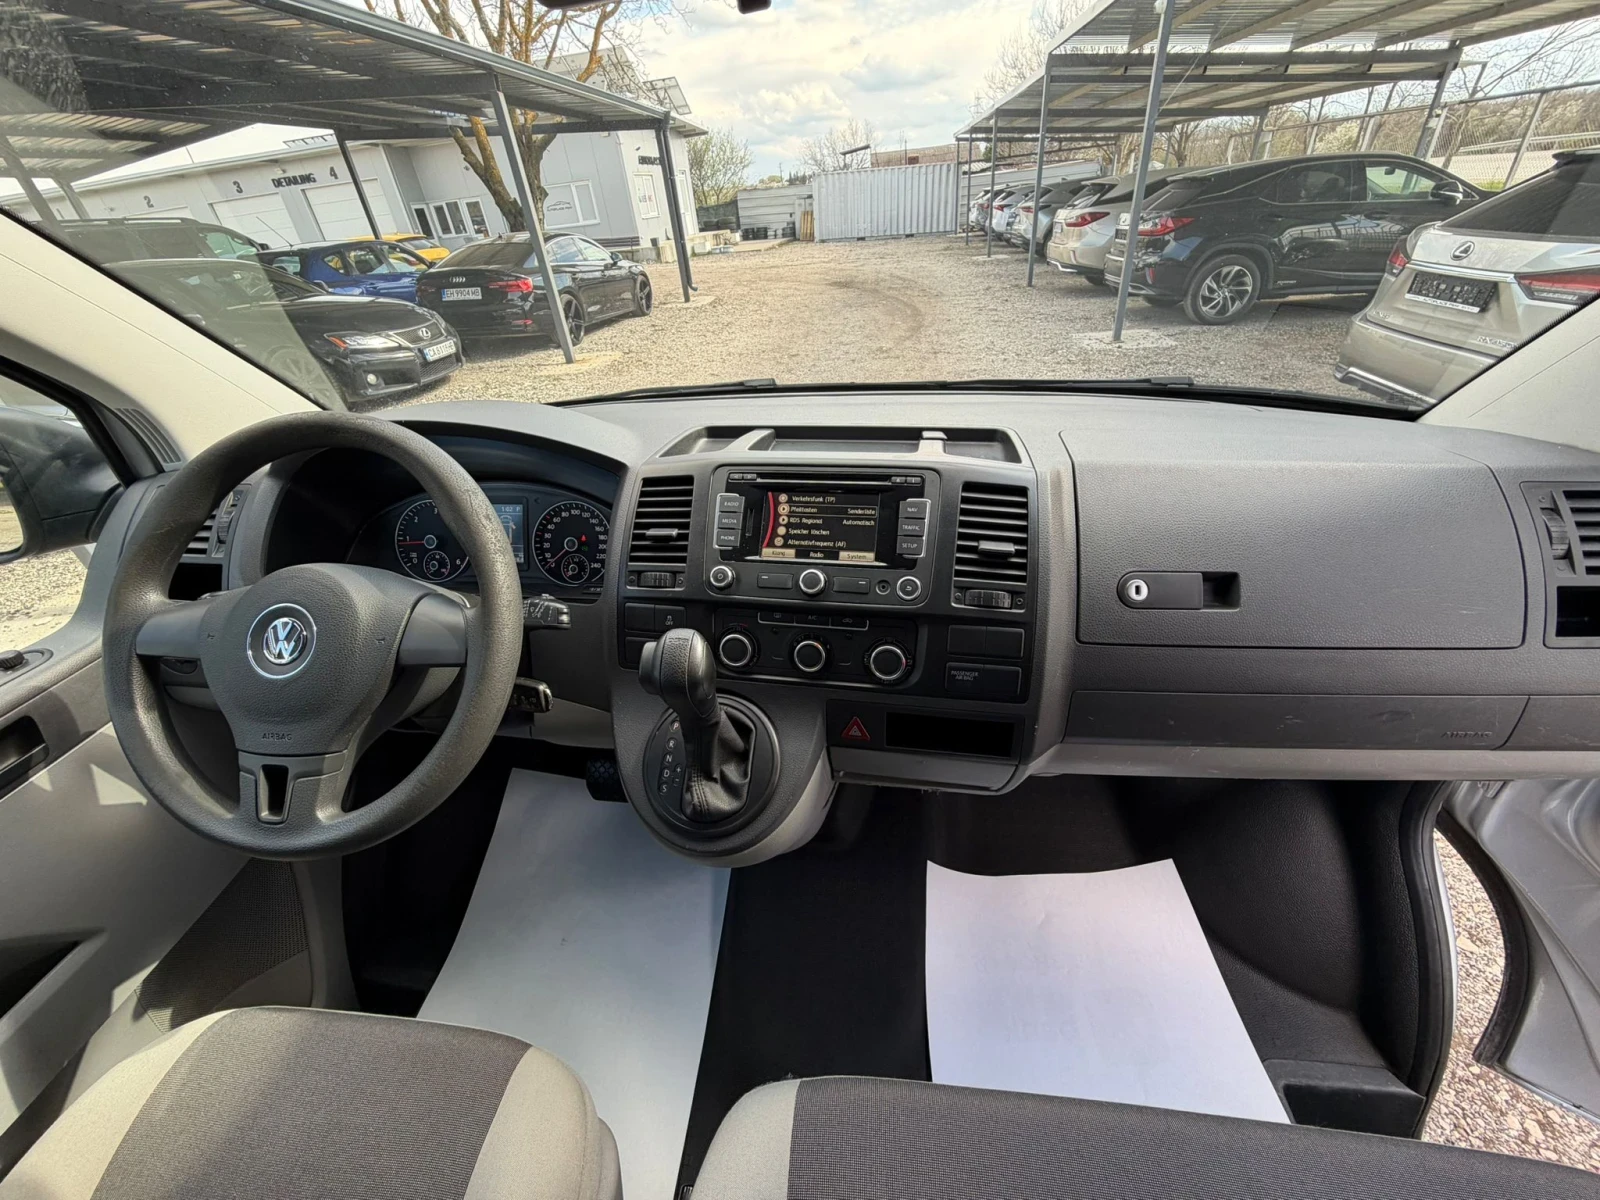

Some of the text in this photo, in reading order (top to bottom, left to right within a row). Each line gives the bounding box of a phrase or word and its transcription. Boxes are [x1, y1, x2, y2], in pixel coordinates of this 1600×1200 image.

[329, 166, 339, 180] 4
[271, 172, 317, 188] DETAILING
[232, 180, 244, 194] 3
[143, 195, 155, 208] 2
[455, 288, 471, 297] 9904
[262, 732, 292, 741] AIRBAG
[1440, 731, 1493, 739] AIRBAG
